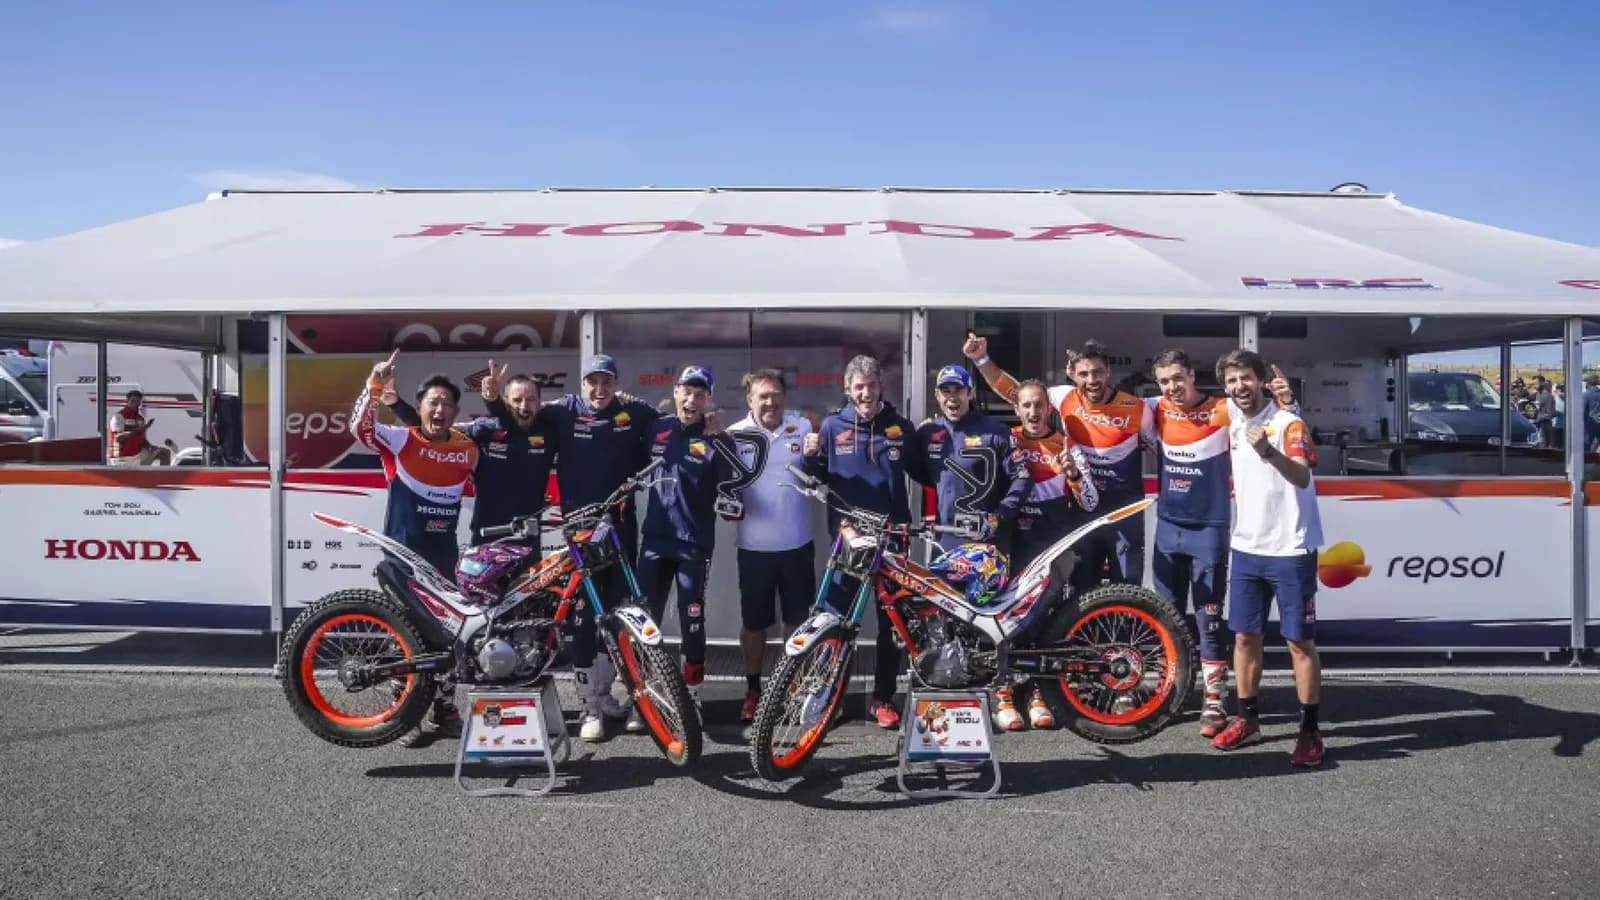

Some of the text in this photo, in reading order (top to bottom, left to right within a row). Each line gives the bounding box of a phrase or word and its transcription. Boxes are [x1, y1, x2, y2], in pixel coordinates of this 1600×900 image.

[394, 220, 1184, 241] HONDA
[286, 412, 347, 440] eps
[1073, 407, 1131, 428] repsol
[420, 447, 469, 464] repsol
[44, 540, 202, 562] HONDA
[1387, 550, 1504, 583] repsol
